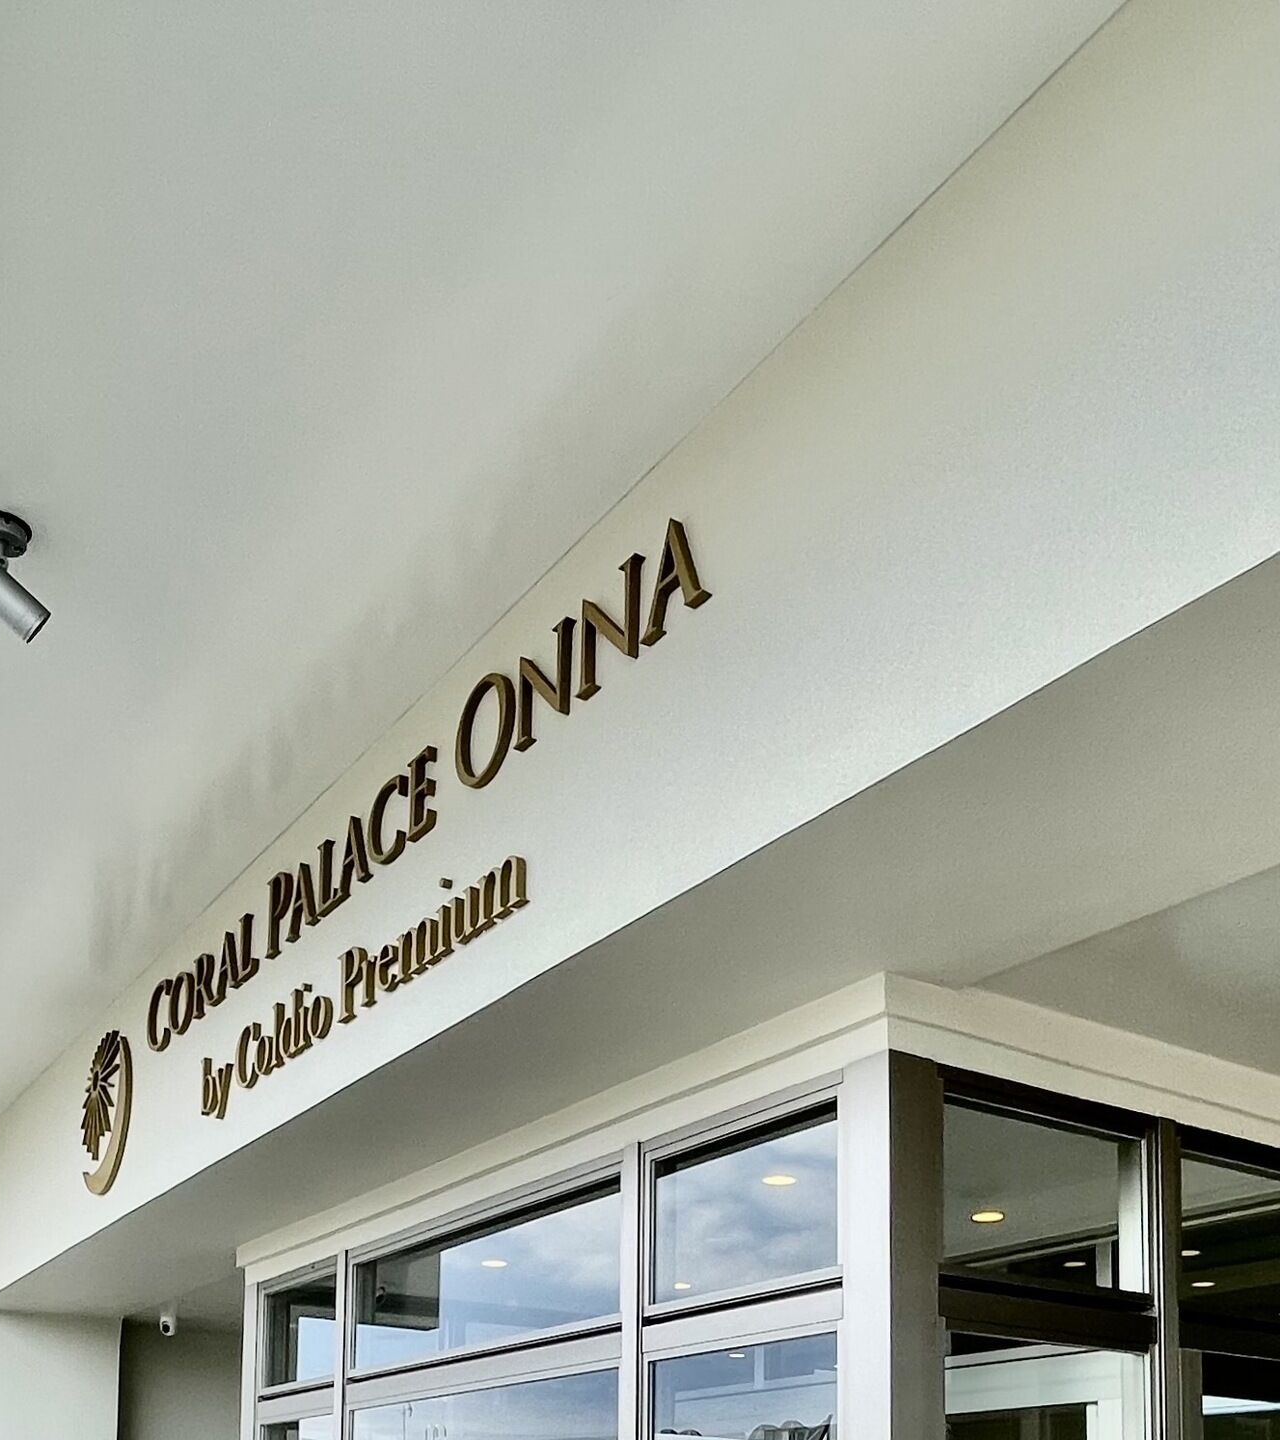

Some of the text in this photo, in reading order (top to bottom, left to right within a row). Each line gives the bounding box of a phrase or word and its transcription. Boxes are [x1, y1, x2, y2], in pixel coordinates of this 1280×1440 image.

[147, 518, 712, 1052] CORAL PALACE ONNA
[199, 1057, 234, 1120] by
[337, 855, 530, 1024] Premium
